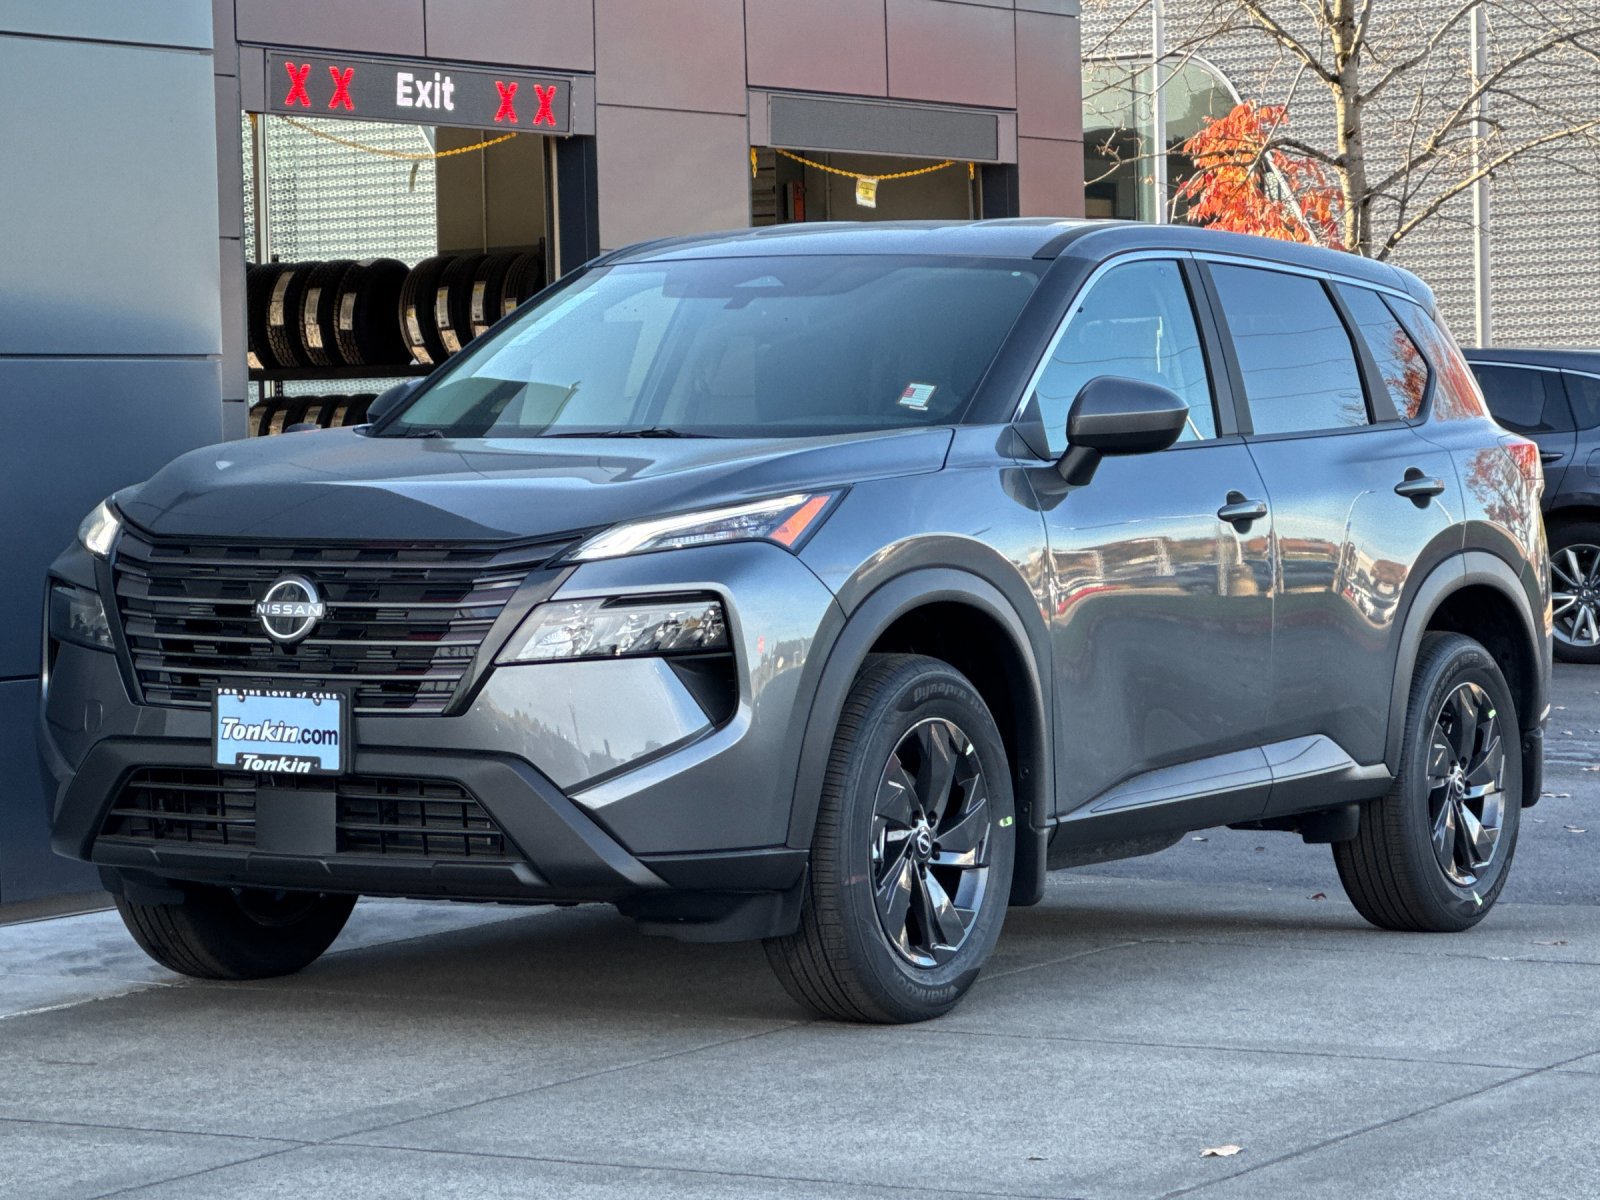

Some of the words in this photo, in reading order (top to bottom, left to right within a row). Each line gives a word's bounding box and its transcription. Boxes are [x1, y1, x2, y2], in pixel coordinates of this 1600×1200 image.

[396, 71, 455, 111] Exit
[256, 604, 320, 615] NISSAN
[217, 687, 238, 695] FOR
[221, 717, 338, 745] Tonkin.com
[242, 754, 312, 774] Tonkin
